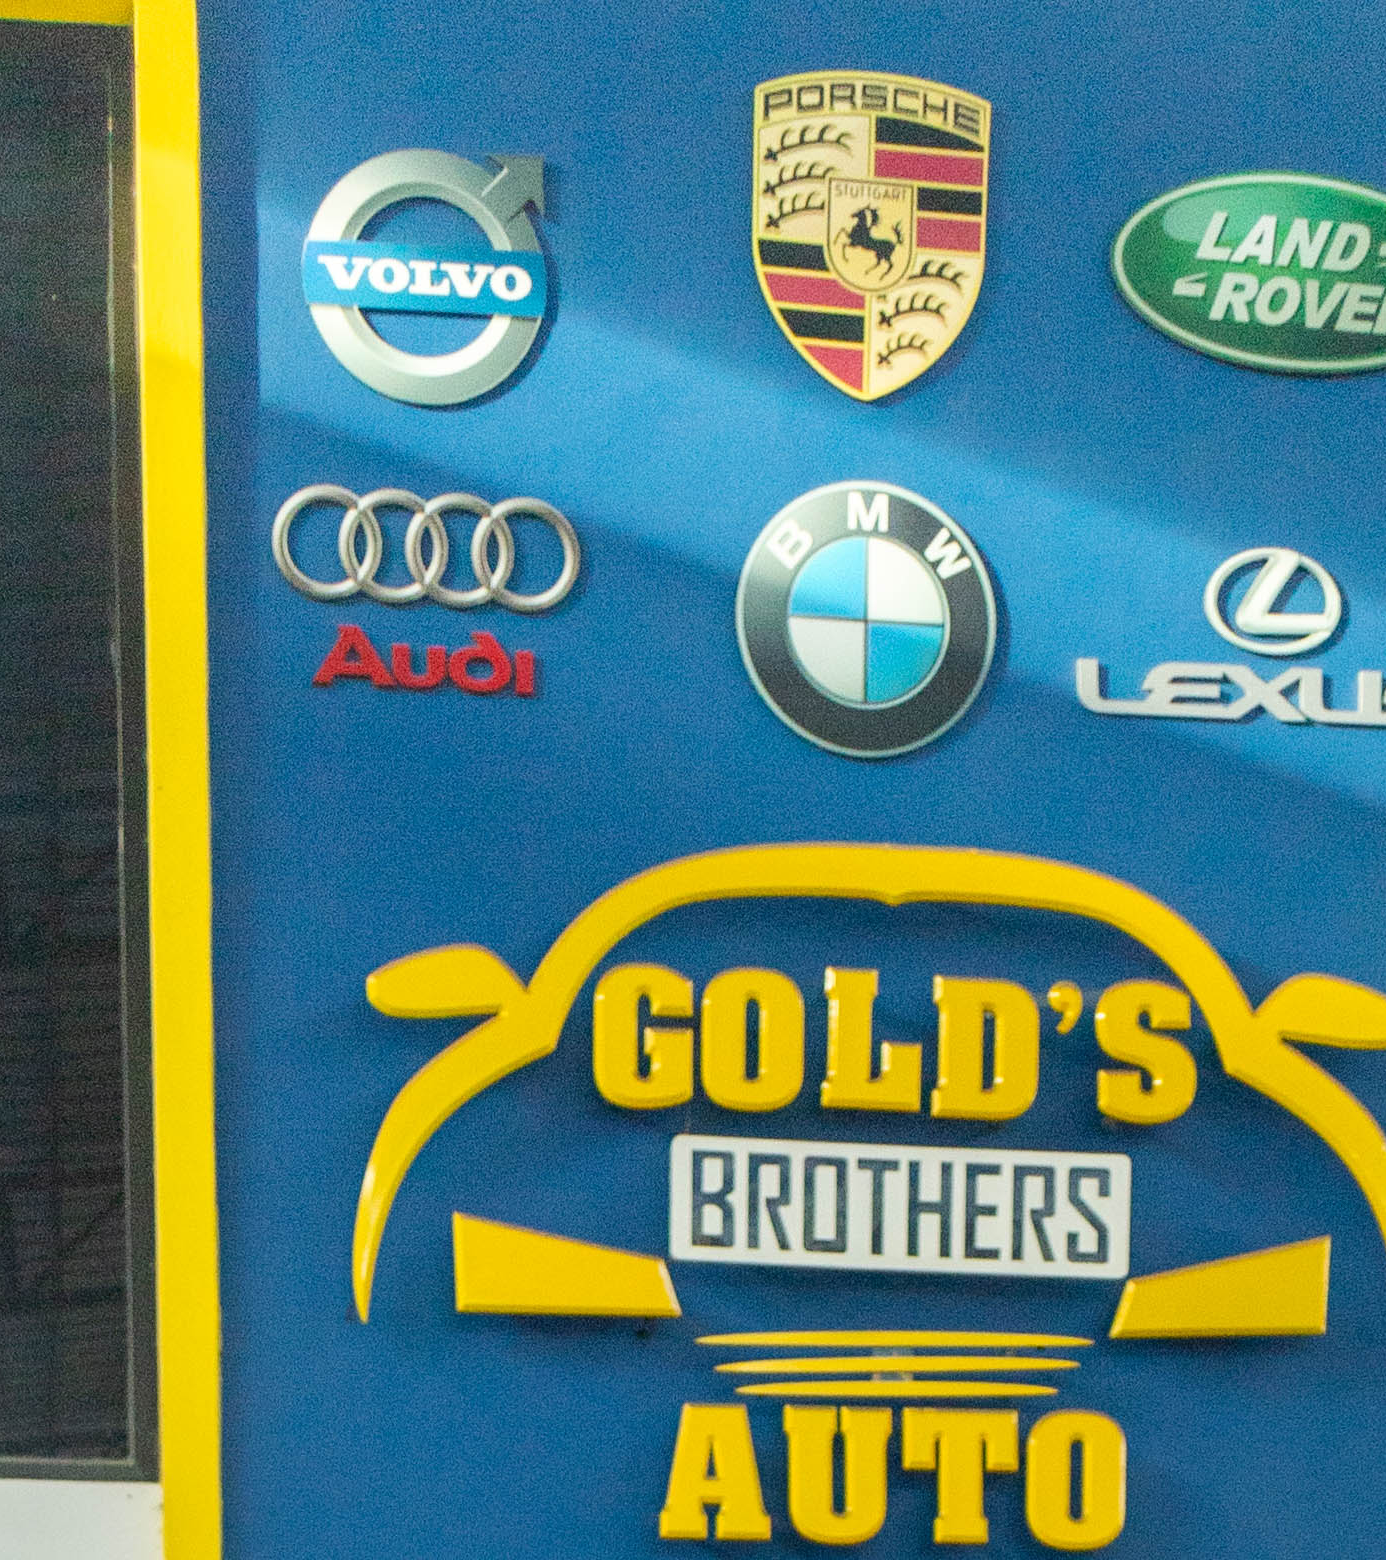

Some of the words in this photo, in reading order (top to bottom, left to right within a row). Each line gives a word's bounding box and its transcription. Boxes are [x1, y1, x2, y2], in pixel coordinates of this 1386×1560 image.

[762, 82, 982, 136] PORSCHE
[318, 255, 533, 302] VOLVO
[1196, 211, 1369, 275] LAND
[767, 491, 972, 581] BMW
[313, 625, 536, 696] Audi
[591, 962, 1199, 1125] GOLD'S
[689, 1149, 1113, 1266] BROTHERS
[658, 1402, 1127, 1552] AUTO
